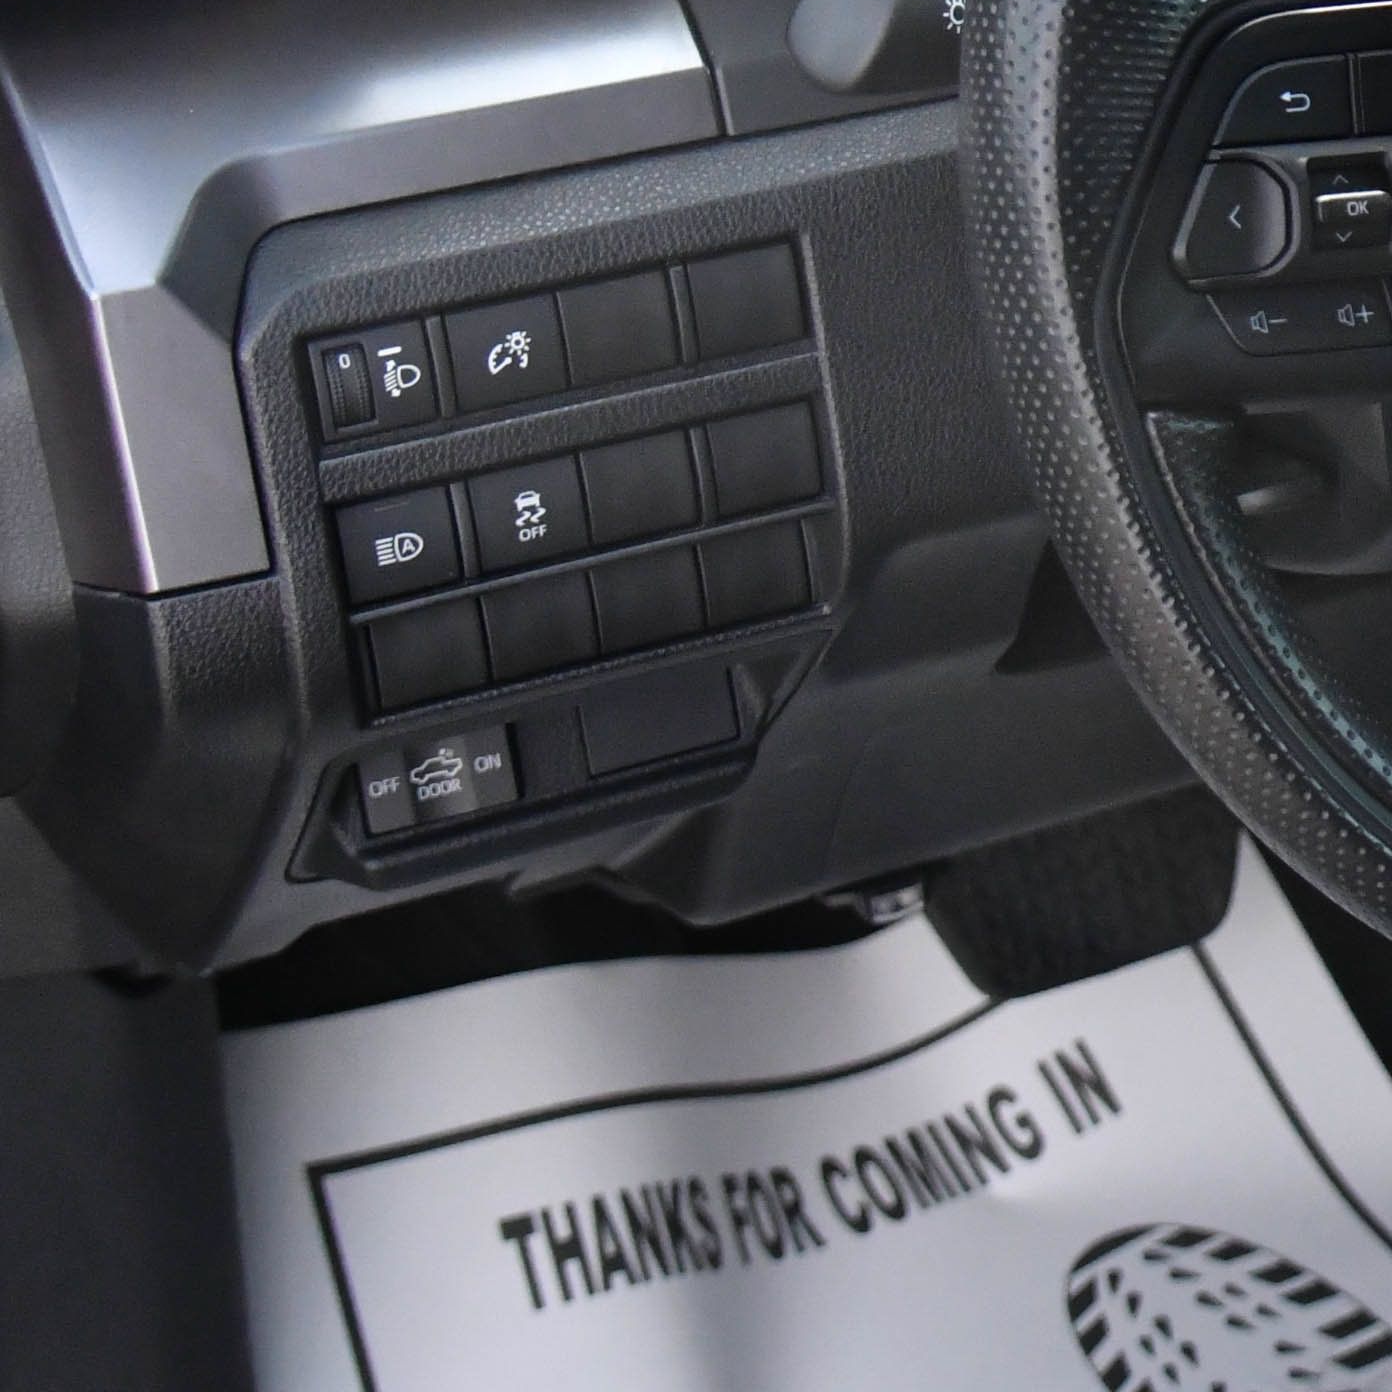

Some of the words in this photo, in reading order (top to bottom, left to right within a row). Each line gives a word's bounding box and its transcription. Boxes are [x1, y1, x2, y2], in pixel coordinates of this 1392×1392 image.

[1346, 200, 1369, 217] OK
[338, 353, 351, 369] 0
[518, 523, 548, 543] OFF
[474, 752, 502, 773] ON
[369, 776, 401, 798] OFF
[417, 777, 463, 801] DOOR
[498, 1169, 722, 1310] THANKS
[722, 1165, 827, 1268] FOR
[819, 1083, 1046, 1235] COMING
[1037, 1037, 1124, 1136] IN
